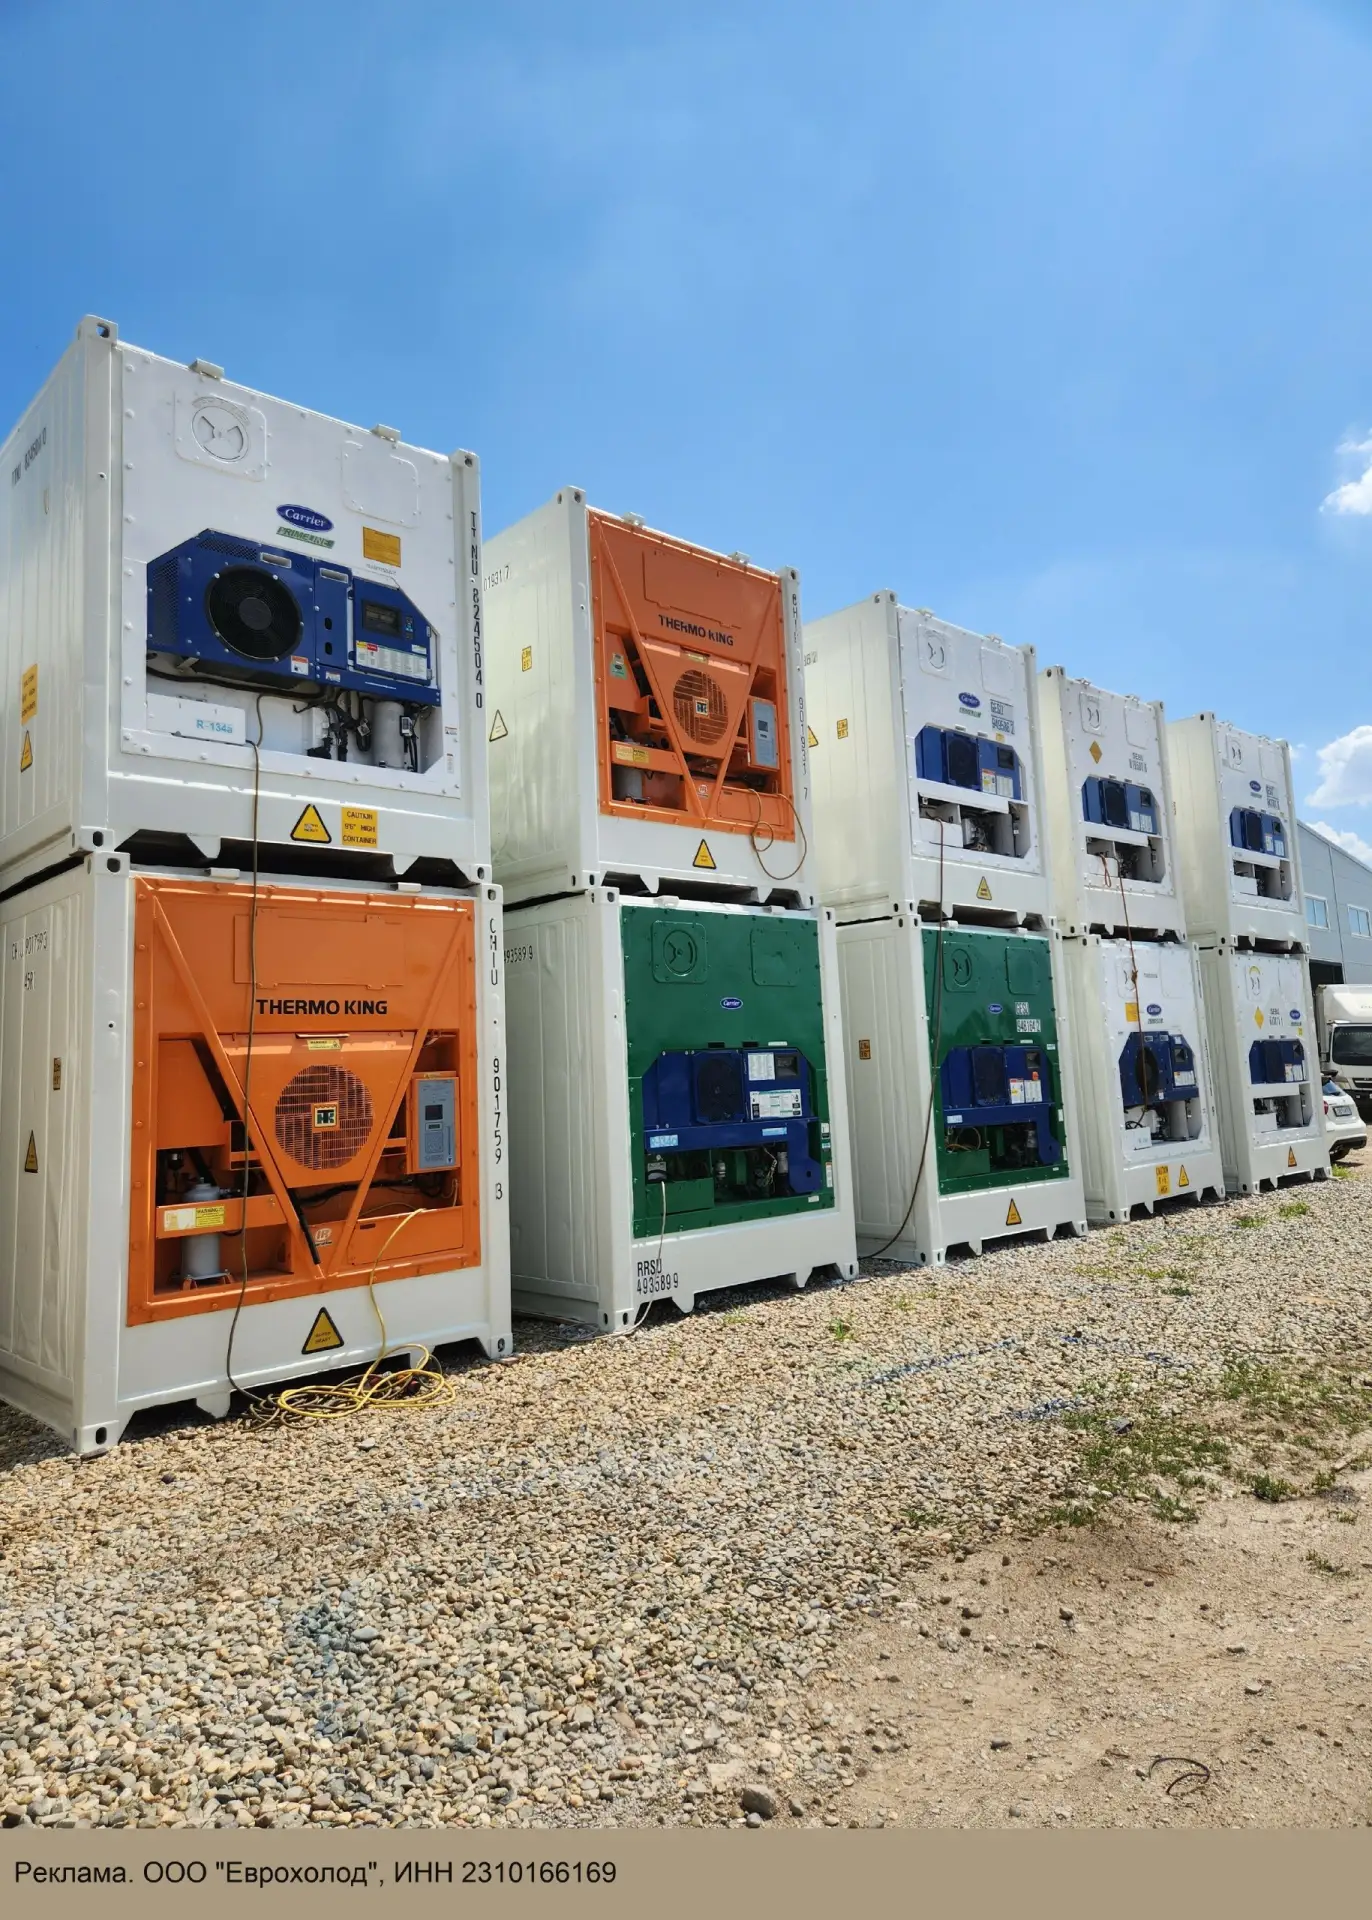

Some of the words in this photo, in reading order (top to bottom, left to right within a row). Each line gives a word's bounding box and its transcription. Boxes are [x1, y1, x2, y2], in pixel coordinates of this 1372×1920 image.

[284, 508, 327, 527] Carrier
[472, 588, 483, 686] 824504
[658, 614, 706, 638] THERMO
[708, 629, 734, 647] KING
[475, 692, 483, 708] 0
[196, 719, 233, 734] R-134a
[489, 918, 498, 986] CHIU
[255, 999, 340, 1015] THERMO
[344, 1000, 388, 1015] KING
[493, 1058, 502, 1164] 901759
[637, 1258, 662, 1277] RRSU
[637, 1274, 671, 1295] 493589
[673, 1273, 679, 1288] 9
